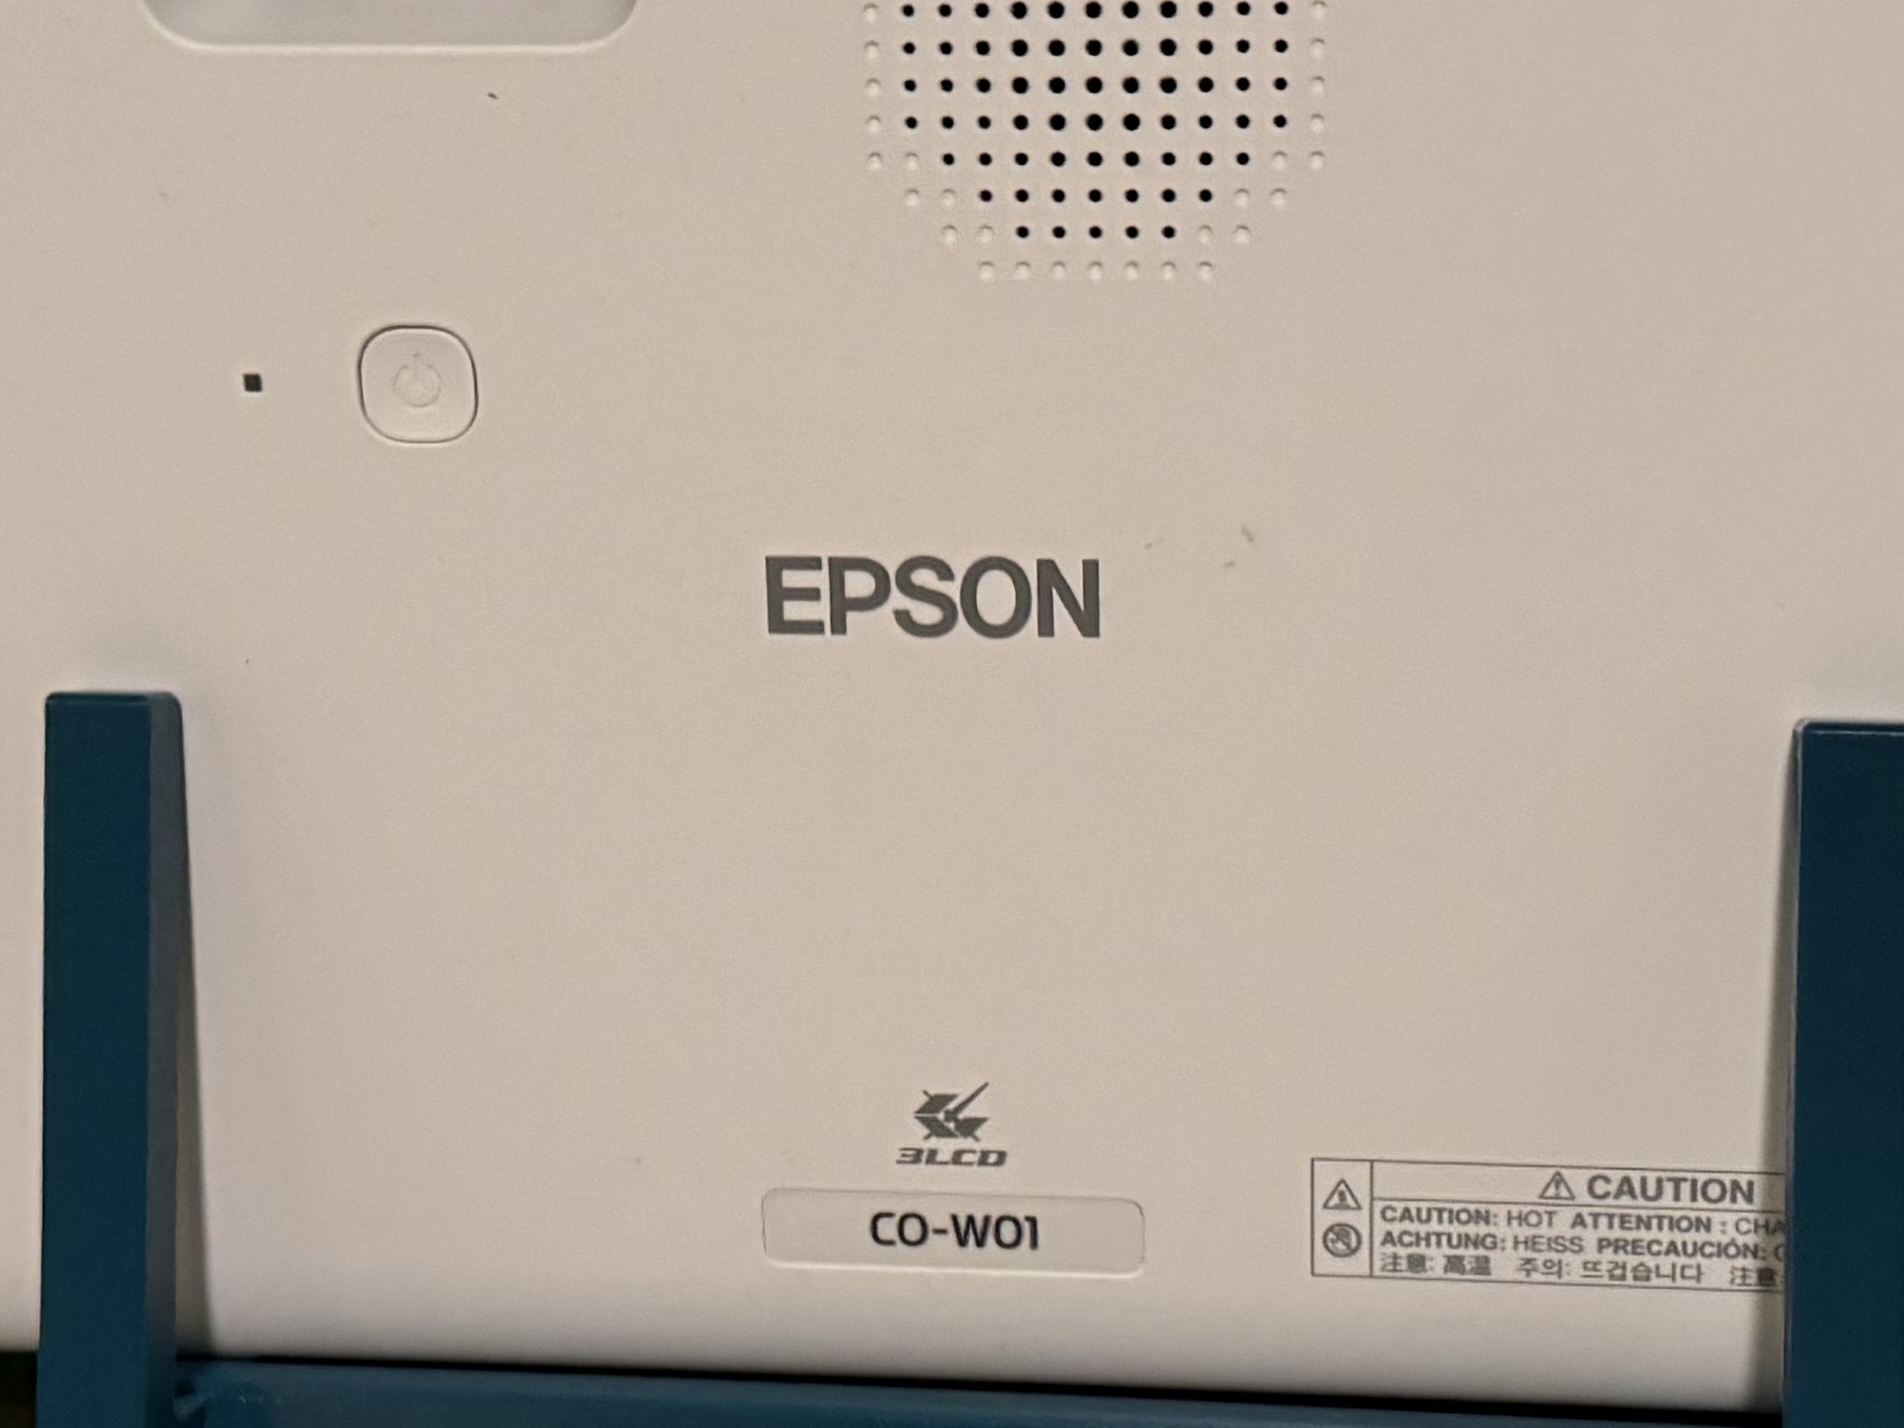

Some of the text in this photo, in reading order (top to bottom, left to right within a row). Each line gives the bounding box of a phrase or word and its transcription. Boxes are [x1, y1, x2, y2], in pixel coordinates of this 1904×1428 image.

[764, 554, 1101, 639] EPSON
[895, 1146, 1008, 1168] 3LCD
[1586, 1174, 1756, 1205] CAUTION
[868, 1210, 1041, 1252] CO-W01
[1379, 1204, 1499, 1227] CAUTION:
[1506, 1209, 1558, 1228] HOT
[1570, 1211, 1713, 1234] ATTENTION
[1734, 1216, 1786, 1236] CHA
[1379, 1230, 1506, 1252] ACHTUNG:
[1512, 1234, 1585, 1254] HEISS
[1596, 1236, 1768, 1262] PRECAUCIÓN:
